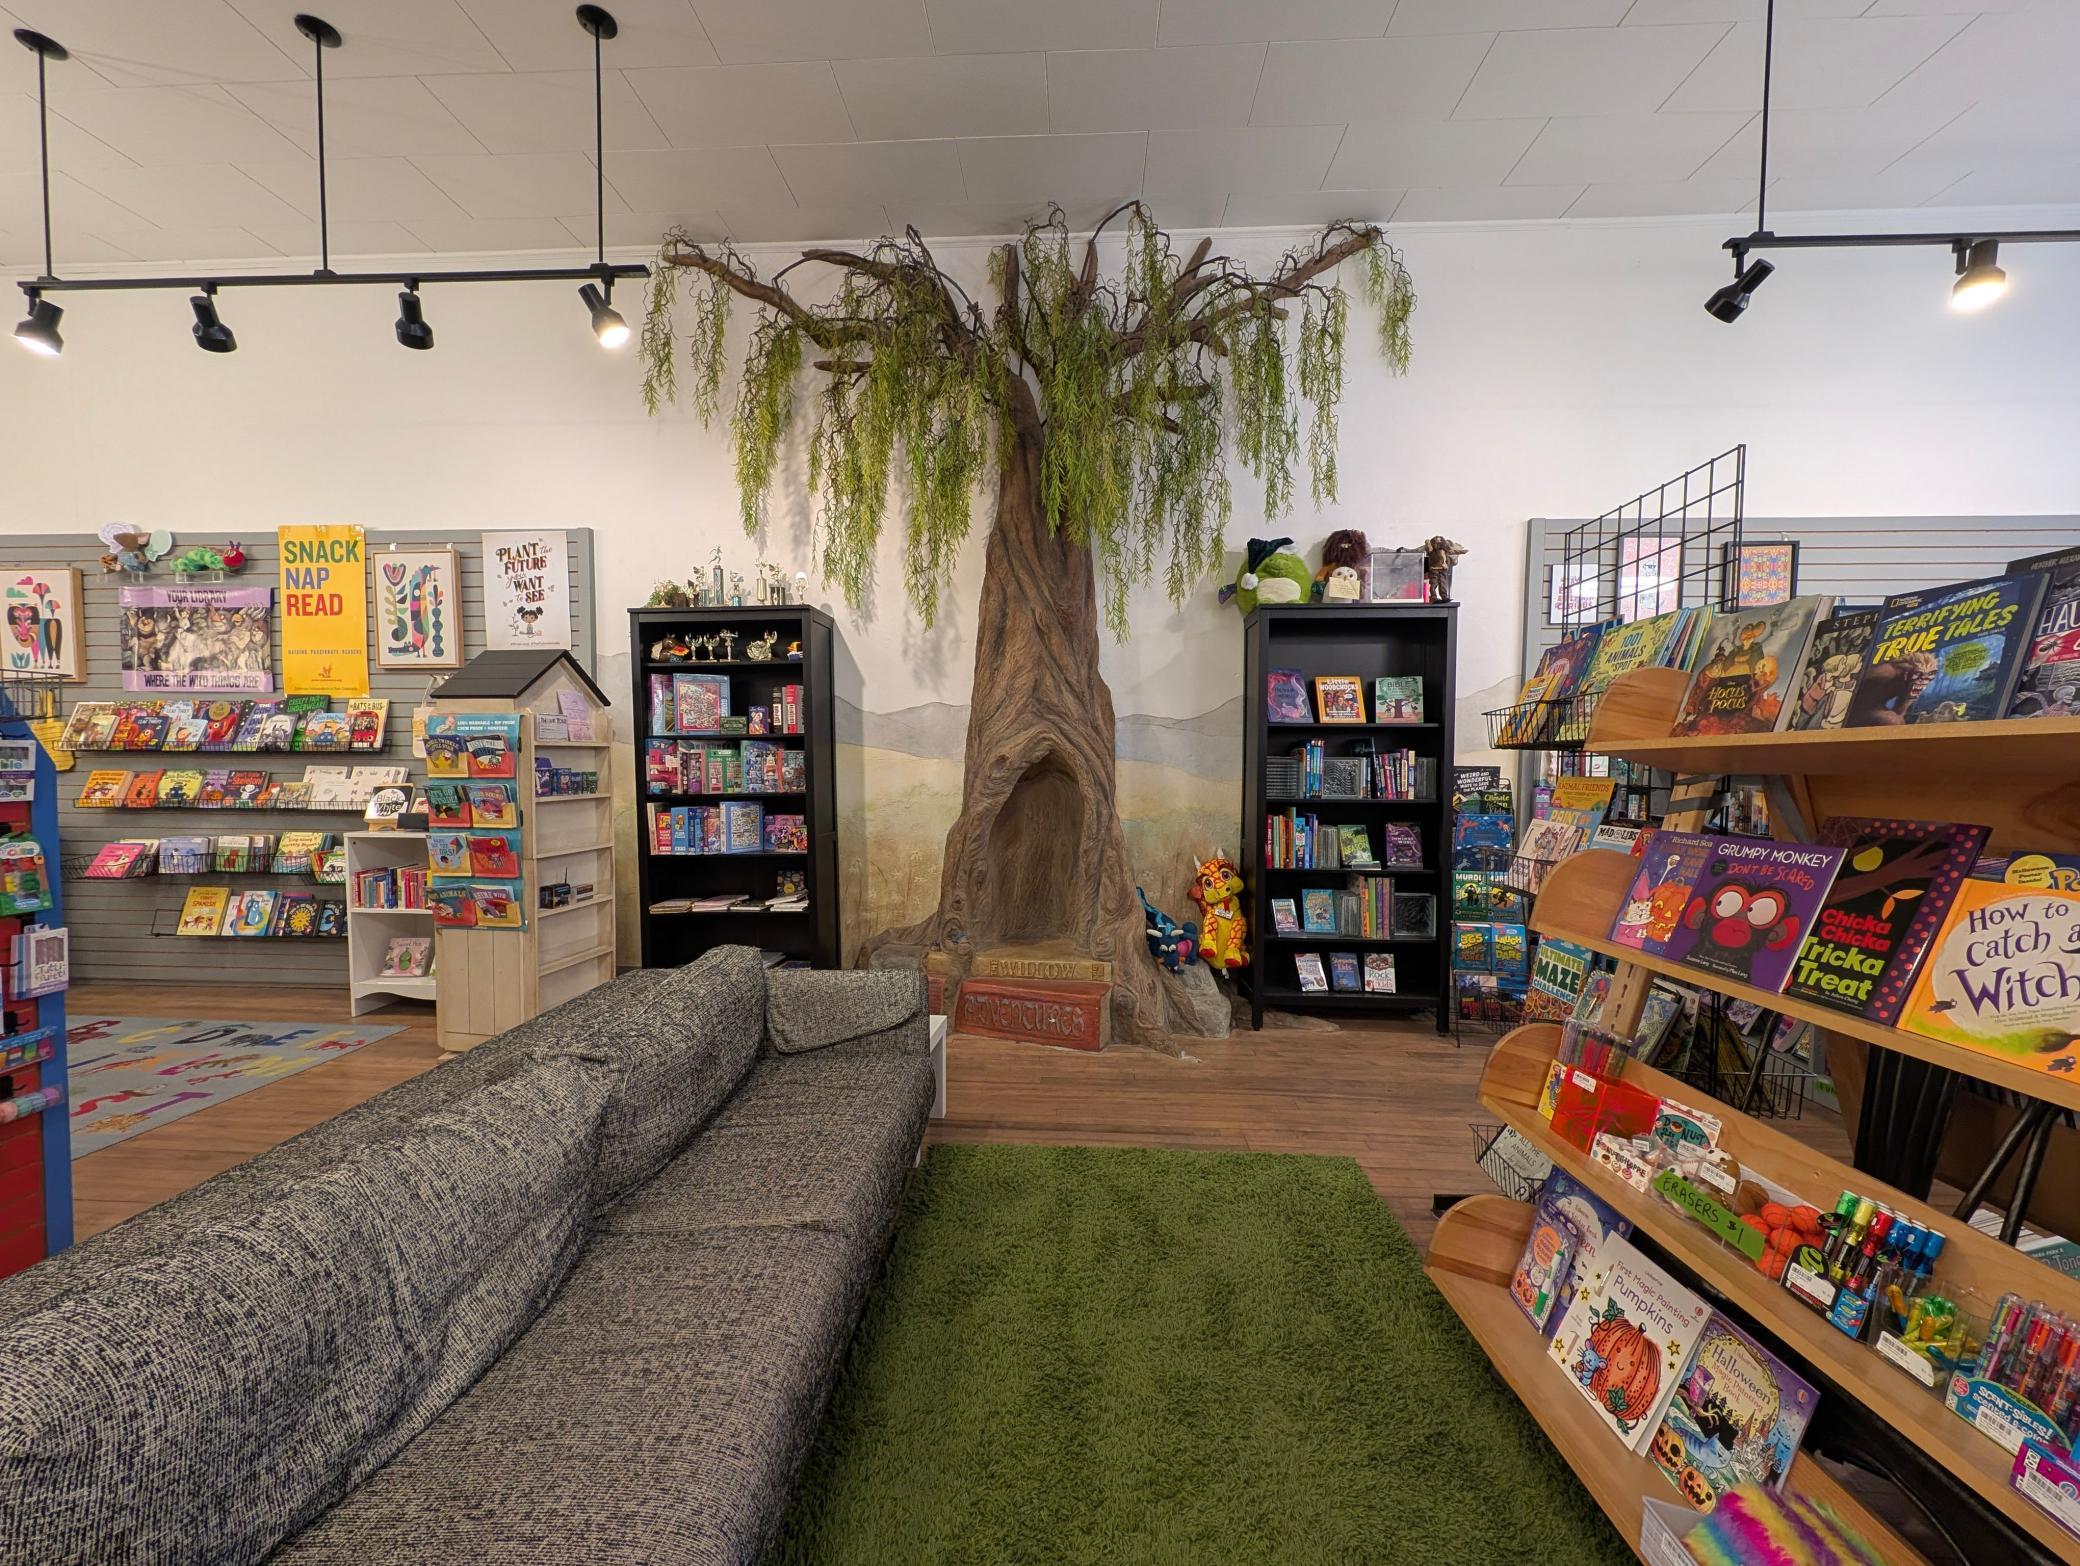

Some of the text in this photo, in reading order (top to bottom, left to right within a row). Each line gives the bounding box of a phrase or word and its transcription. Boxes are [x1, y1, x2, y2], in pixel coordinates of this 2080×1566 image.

[284, 539, 360, 564] SNACK
[496, 542, 552, 562] PLANT the
[504, 556, 547, 575] FUTURE
[285, 567, 330, 590] NAP
[506, 573, 526, 589] you
[513, 576, 544, 593] WANT
[167, 590, 227, 604] YOUR LIBRARY
[286, 593, 343, 616] READ
[525, 589, 545, 603] SEE
[1884, 592, 2000, 639] TERRIFYING
[1621, 631, 1644, 648] 1001
[1873, 604, 2019, 664] TRUE TALES
[1605, 644, 1647, 664] ANIMALS
[1613, 661, 1632, 672] SPOT
[144, 675, 259, 688] WHERE THE WILD THINGS ARE
[1708, 685, 1747, 699] HOCUS
[1708, 697, 1747, 713] POCUS
[1457, 776, 1492, 784] WONDERFUL
[1581, 783, 1610, 792] FRIENDS
[377, 793, 401, 802] Black
[1599, 827, 1639, 840] MAD LIBS
[1672, 836, 1699, 846] Richard
[1718, 843, 1833, 868] GRUMPY MONKEY
[1728, 863, 1815, 891] DON'T BE SCARED
[1821, 908, 1893, 935] Chicka
[1967, 902, 2069, 936] How to
[1820, 926, 1892, 951] Chicka
[1966, 921, 2052, 968] Catch
[1540, 945, 1582, 973] ULTIMATE
[1800, 936, 1885, 976] Tricka
[1535, 957, 1581, 995] MAZE
[1797, 960, 1874, 1000] Treat
[1534, 979, 1577, 1004] CHALLENGE
[1663, 1177, 1719, 1223] ERASERS
[1613, 1274, 1673, 1334] Pumpkins
[1617, 1260, 1632, 1277] First
[1633, 1274, 1657, 1297] Magic
[1656, 1294, 1690, 1328] Painting
[1712, 1344, 1771, 1405] Halloween
[1712, 1362, 1763, 1413] Magic Painting
[1723, 1382, 1741, 1404] Book
